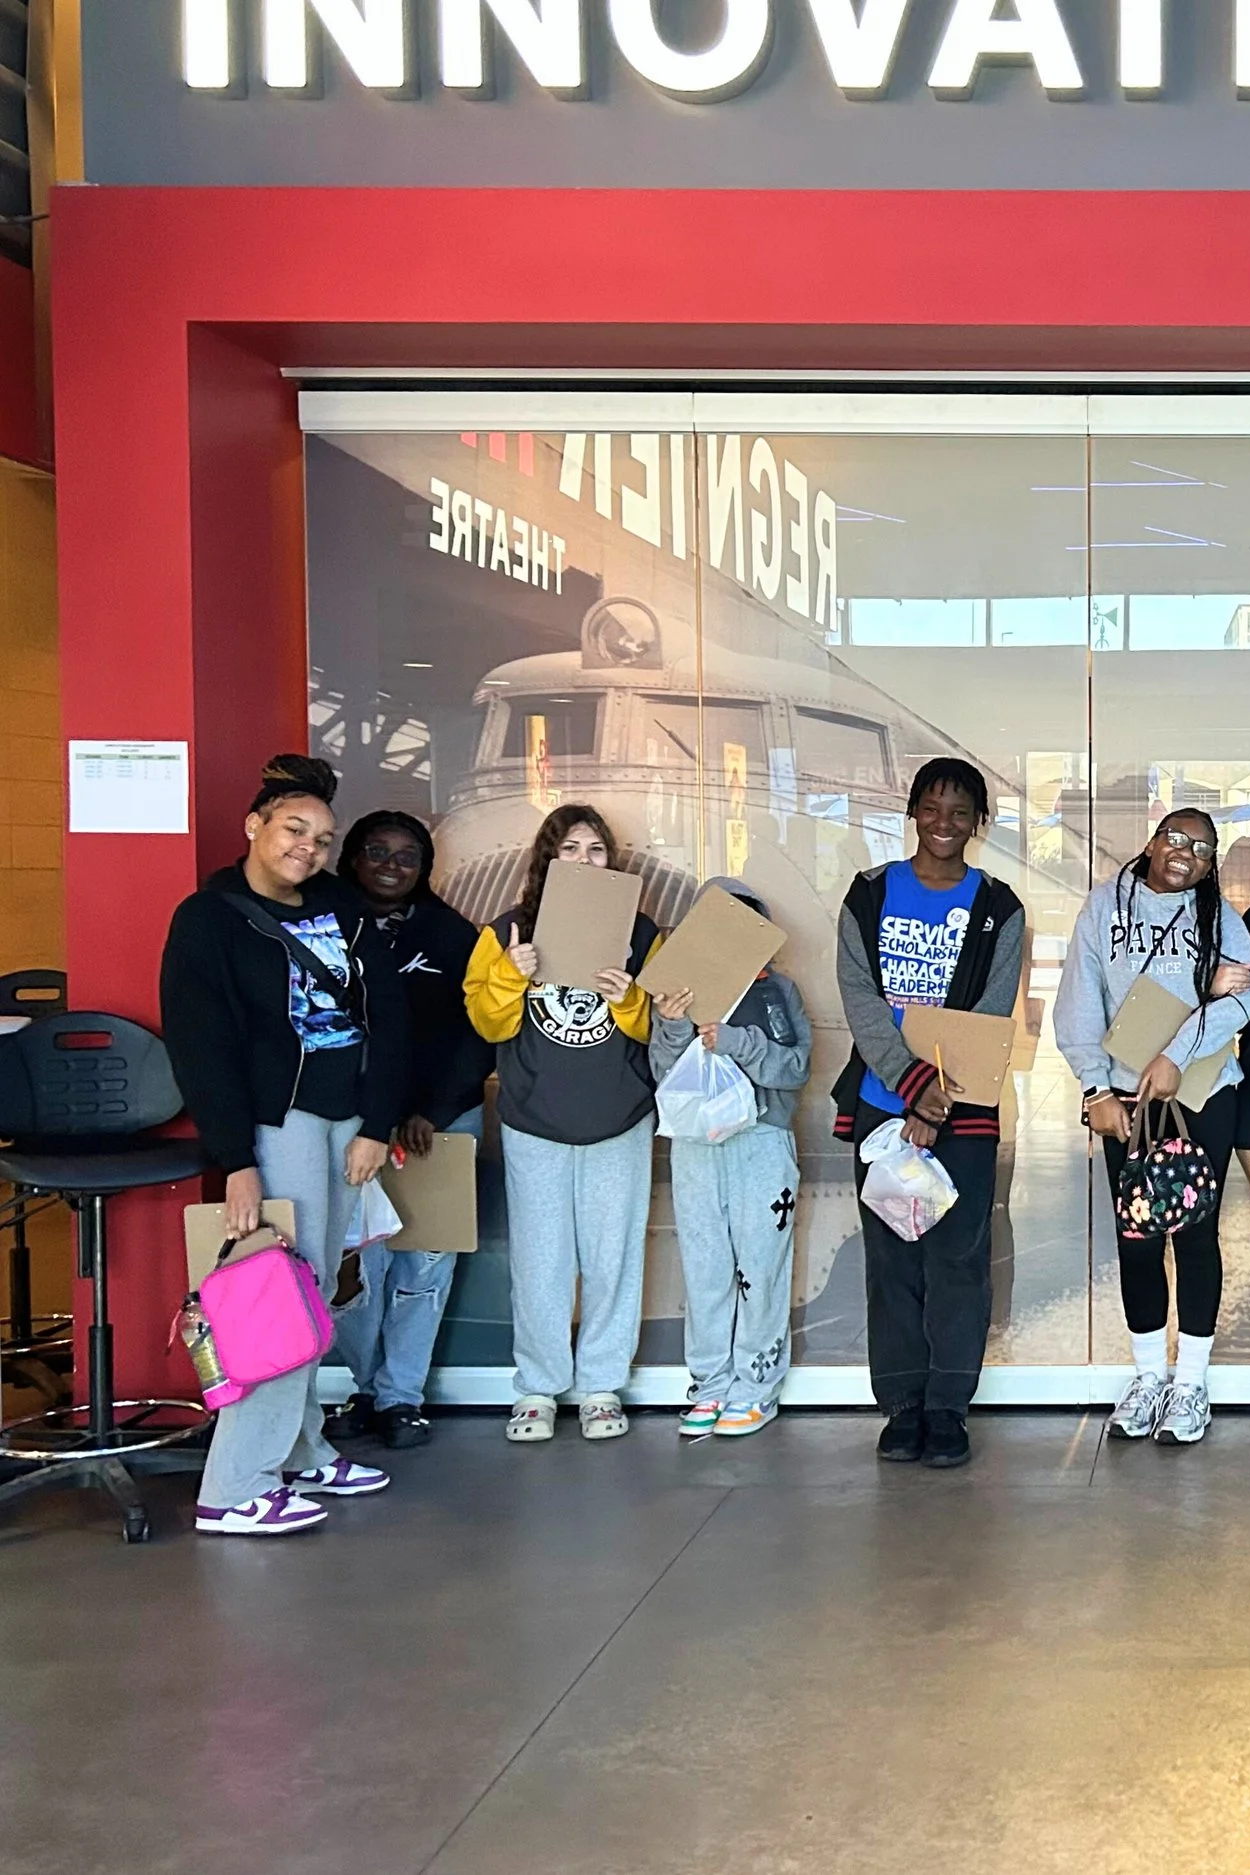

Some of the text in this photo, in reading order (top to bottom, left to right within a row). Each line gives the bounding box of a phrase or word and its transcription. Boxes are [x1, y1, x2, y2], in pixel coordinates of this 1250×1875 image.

[878, 935, 961, 961] SCHOLARSH
[1109, 920, 1200, 965] PARIS
[880, 956, 956, 980] CHARACE
[1130, 960, 1183, 975] FANCE
